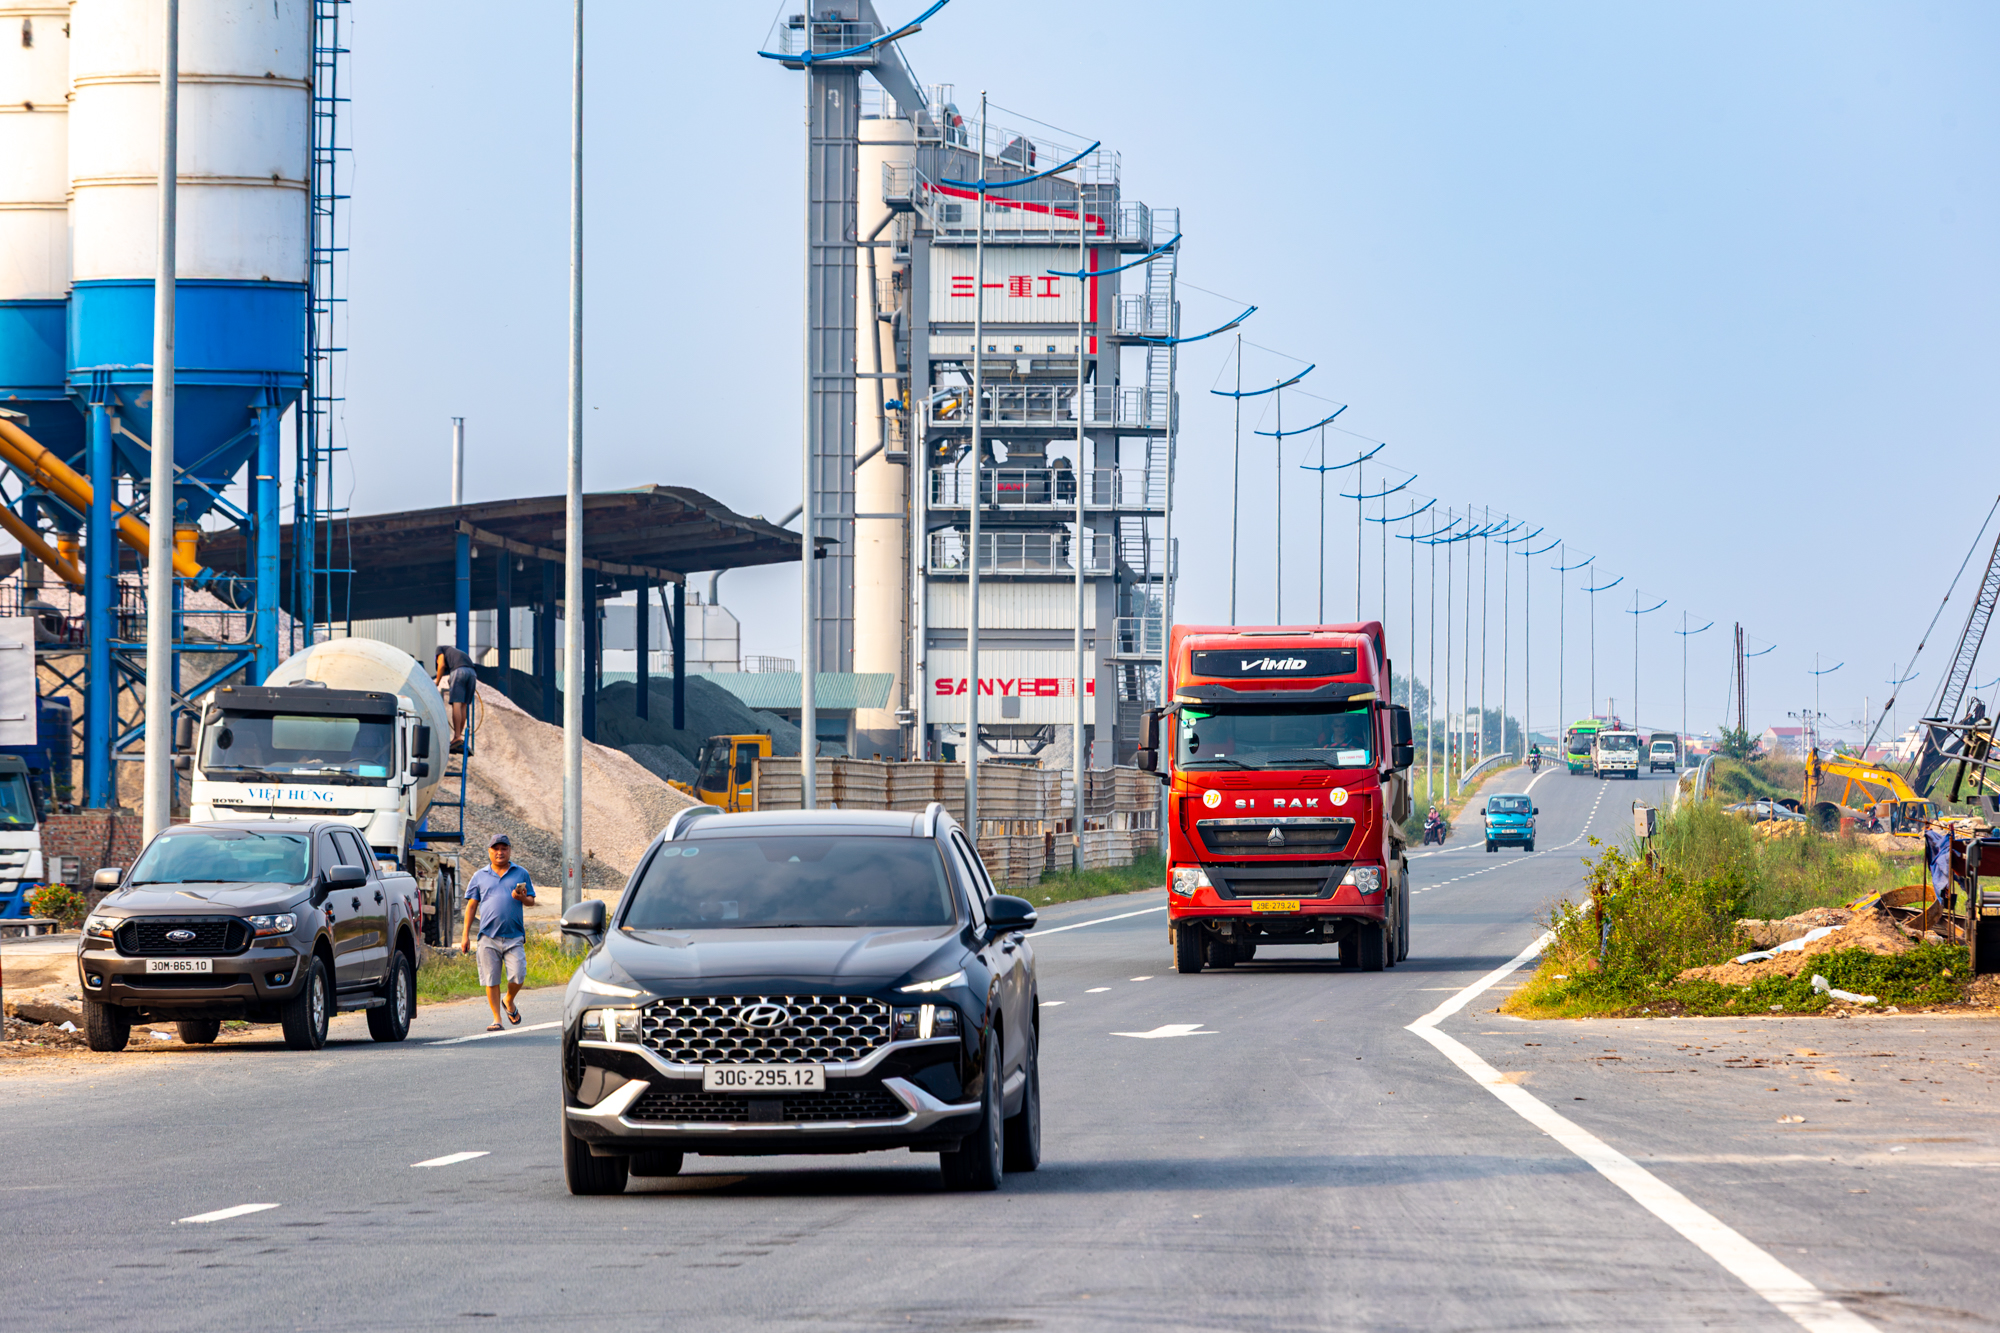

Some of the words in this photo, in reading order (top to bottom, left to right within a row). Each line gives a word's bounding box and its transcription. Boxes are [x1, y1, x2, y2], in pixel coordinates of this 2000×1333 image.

[951, 275, 1061, 298] 三一重工
[935, 678, 1015, 696] SANY
[248, 787, 285, 801] VIỆT
[288, 789, 334, 802] HƯNG
[152, 961, 207, 971] 30M-865.10
[714, 1070, 814, 1086] 30G-295.12
